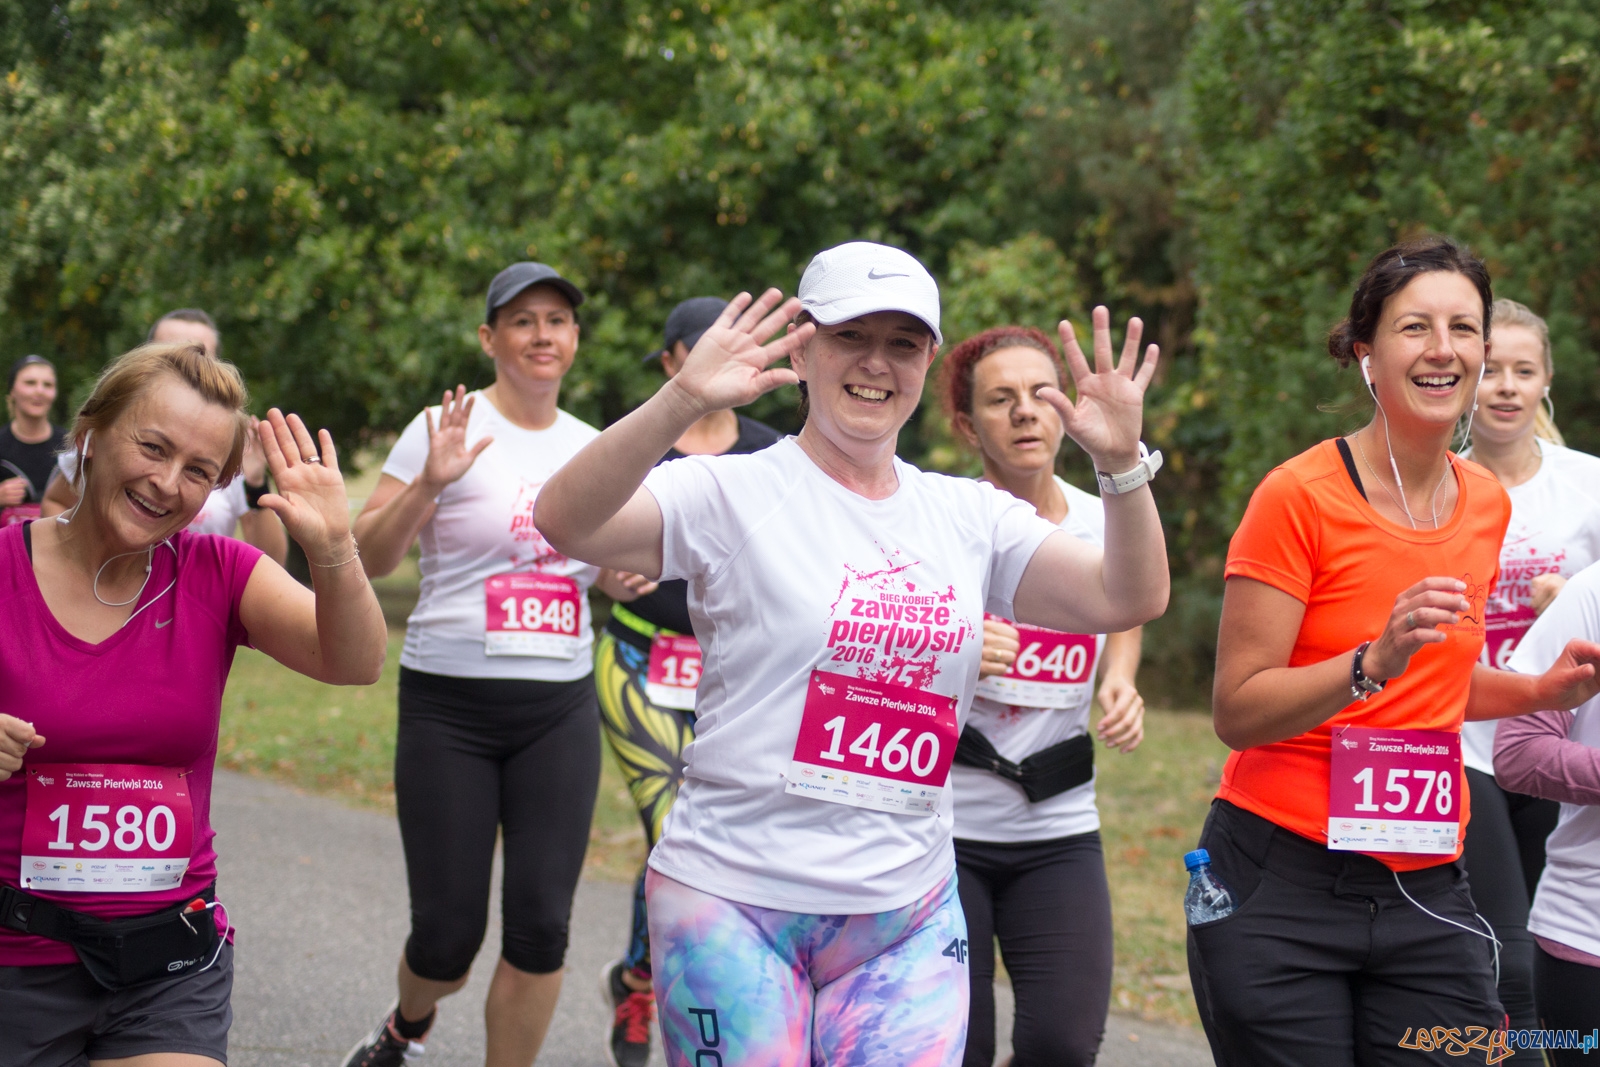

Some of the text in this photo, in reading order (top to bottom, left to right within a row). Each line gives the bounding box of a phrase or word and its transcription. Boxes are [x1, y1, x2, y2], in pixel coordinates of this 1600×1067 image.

[850, 598, 950, 626] zawsze
[880, 593, 935, 605] BIEG KOBIET
[500, 597, 576, 633] 1848
[831, 645, 876, 664] 2016
[1006, 642, 1087, 680] 640
[1481, 638, 1516, 671] 16
[661, 656, 700, 687] 15
[845, 690, 879, 705] Zawsze
[880, 697, 916, 713] Pier(w)si
[916, 704, 937, 716] 2016
[819, 715, 940, 777] 1460
[1369, 742, 1449, 755] Zawsze Pier(w)si 2016
[66, 778, 163, 790] Zawsze Pier(w)si 2016
[1352, 767, 1453, 815] 1578
[48, 804, 176, 852] 1580
[941, 937, 968, 964] 4F
